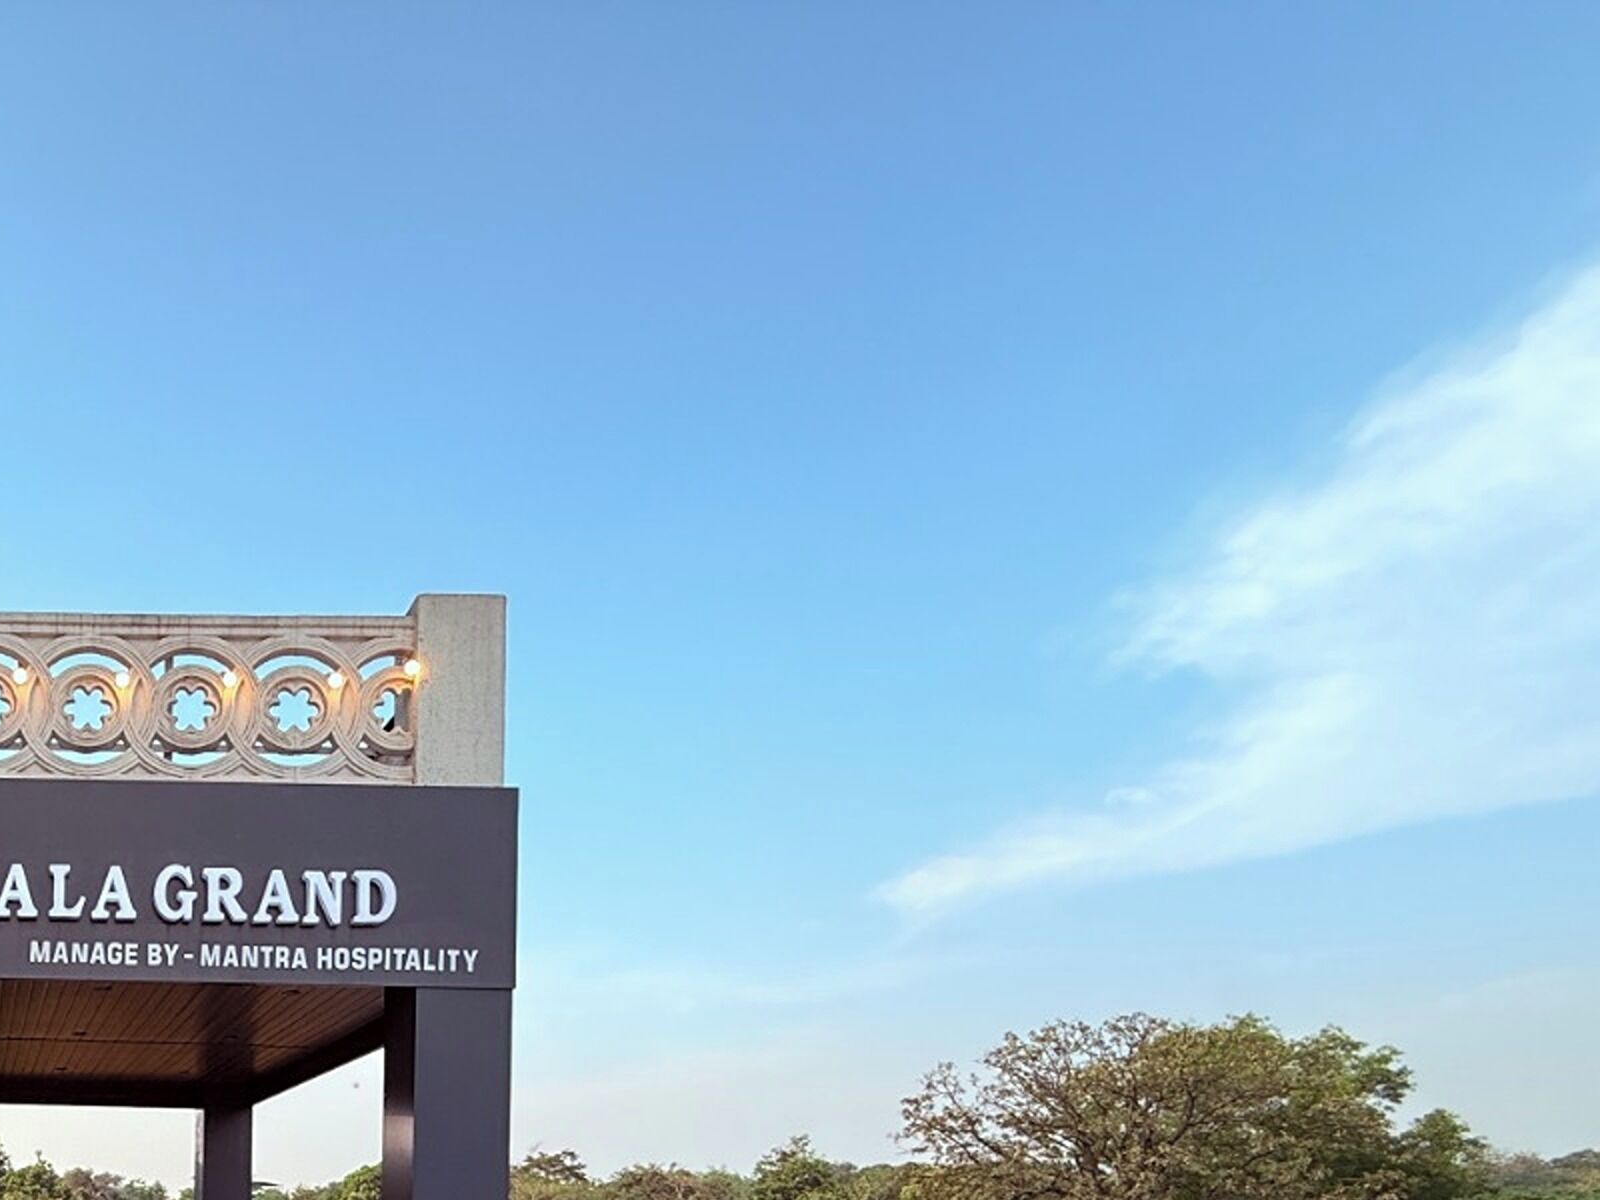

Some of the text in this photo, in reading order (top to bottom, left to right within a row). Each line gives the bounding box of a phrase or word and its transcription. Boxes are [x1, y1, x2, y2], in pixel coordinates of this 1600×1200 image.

[153, 864, 398, 927] GRAND
[29, 940, 138, 966] MANAGE
[200, 944, 308, 970] MANTRA
[316, 946, 479, 973] HOSPITALITY
